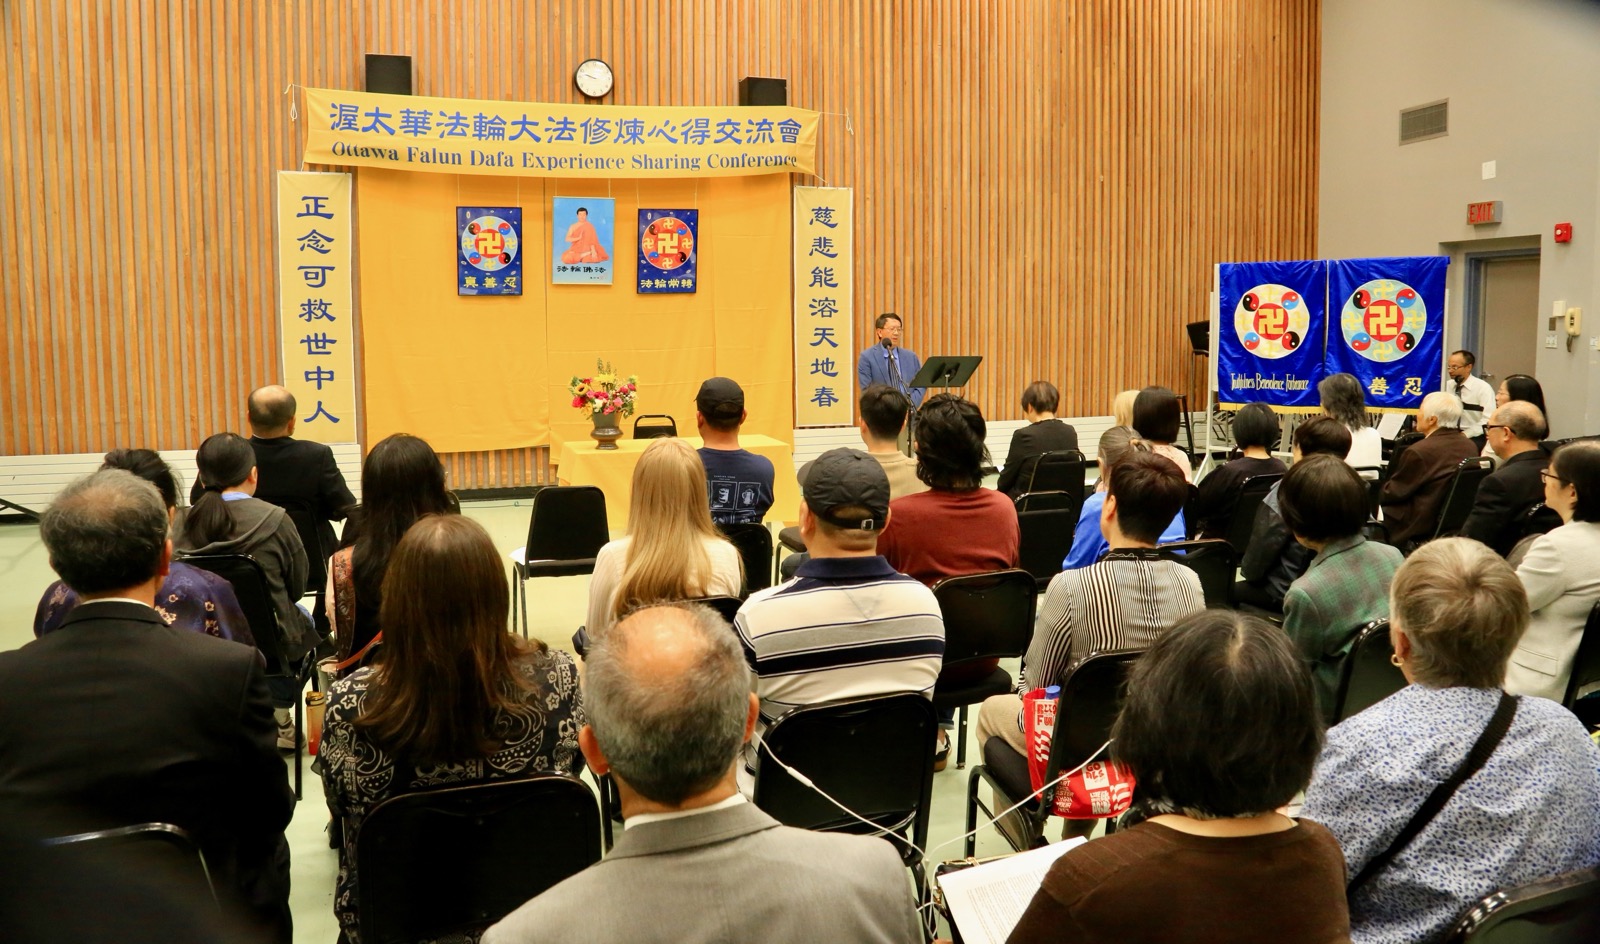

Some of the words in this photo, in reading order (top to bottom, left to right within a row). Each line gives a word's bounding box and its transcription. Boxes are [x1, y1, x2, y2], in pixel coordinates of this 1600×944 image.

[329, 102, 802, 145] 渥太華法輪大法修煉心得交流會
[331, 141, 399, 161] Ottawa
[407, 146, 463, 165] Falun
[470, 150, 515, 168] Dafa
[521, 151, 625, 171] Experience
[631, 153, 701, 171] Sharing
[707, 153, 797, 169] Conference
[1469, 202, 1493, 223] EXIT
[296, 195, 340, 424] 正念可救世中人
[809, 206, 839, 408] 慈悲能溶天地春
